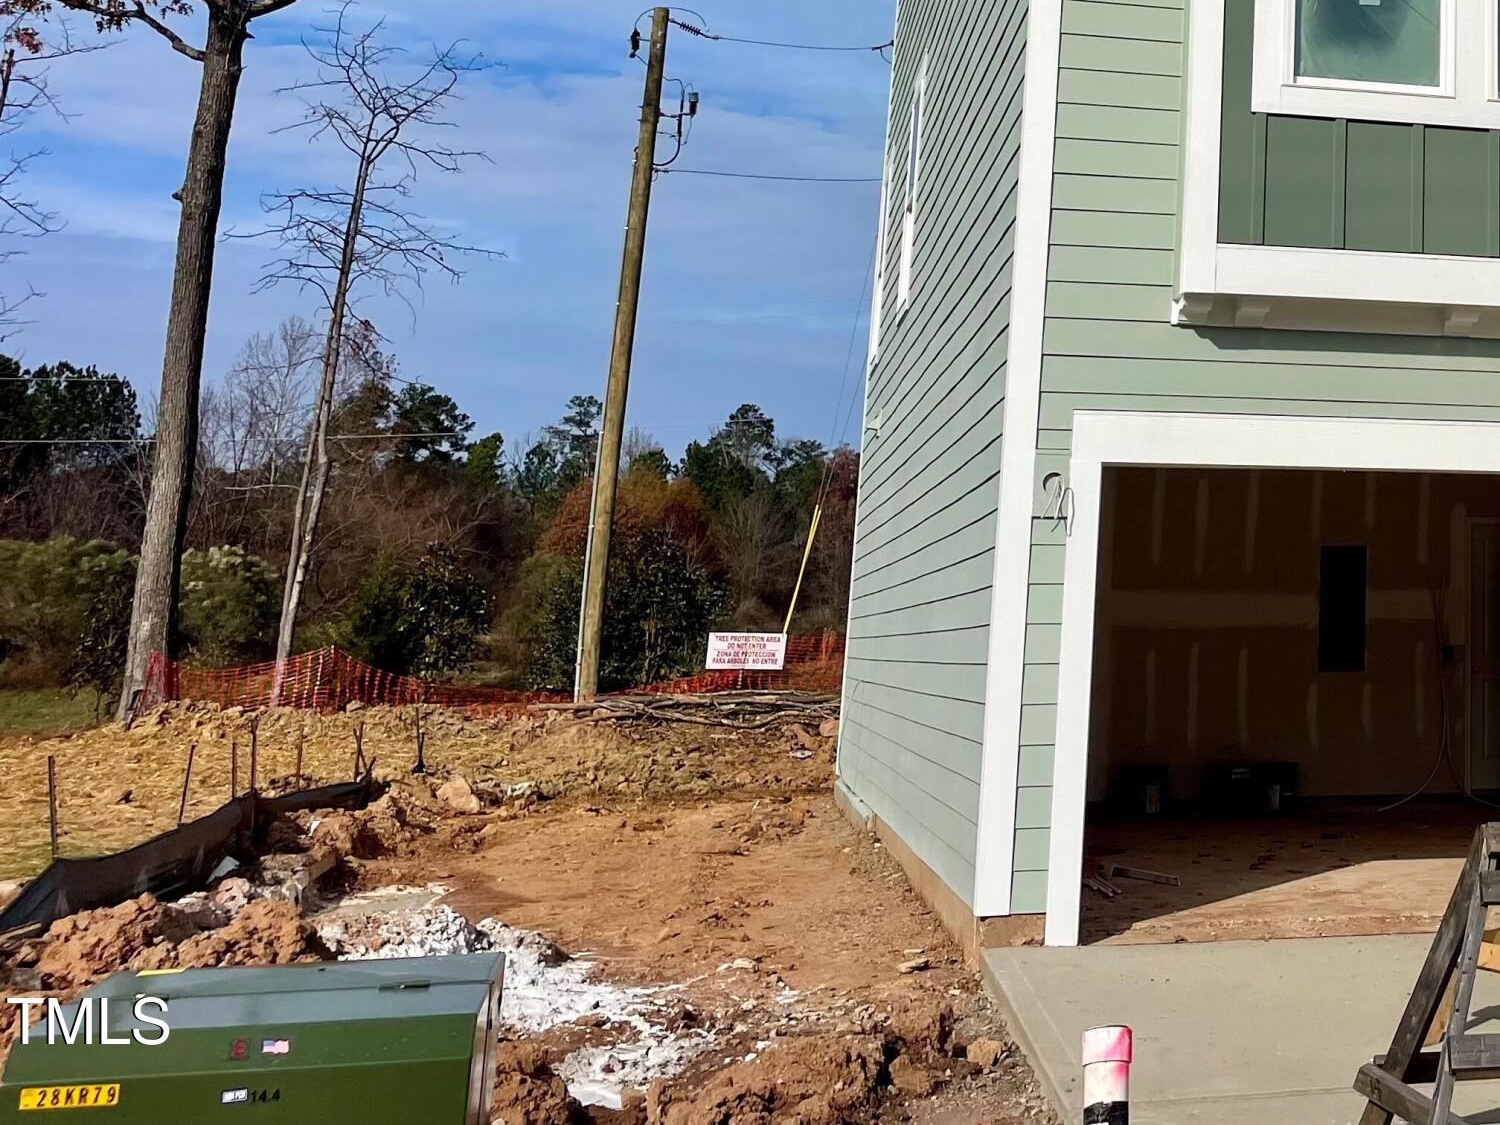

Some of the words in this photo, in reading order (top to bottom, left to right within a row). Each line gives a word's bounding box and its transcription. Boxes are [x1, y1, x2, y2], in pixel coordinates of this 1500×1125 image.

[730, 635, 765, 643] PROTECTION
[36, 1085, 117, 1108] 28KR79
[250, 1088, 281, 1103] 14.4
